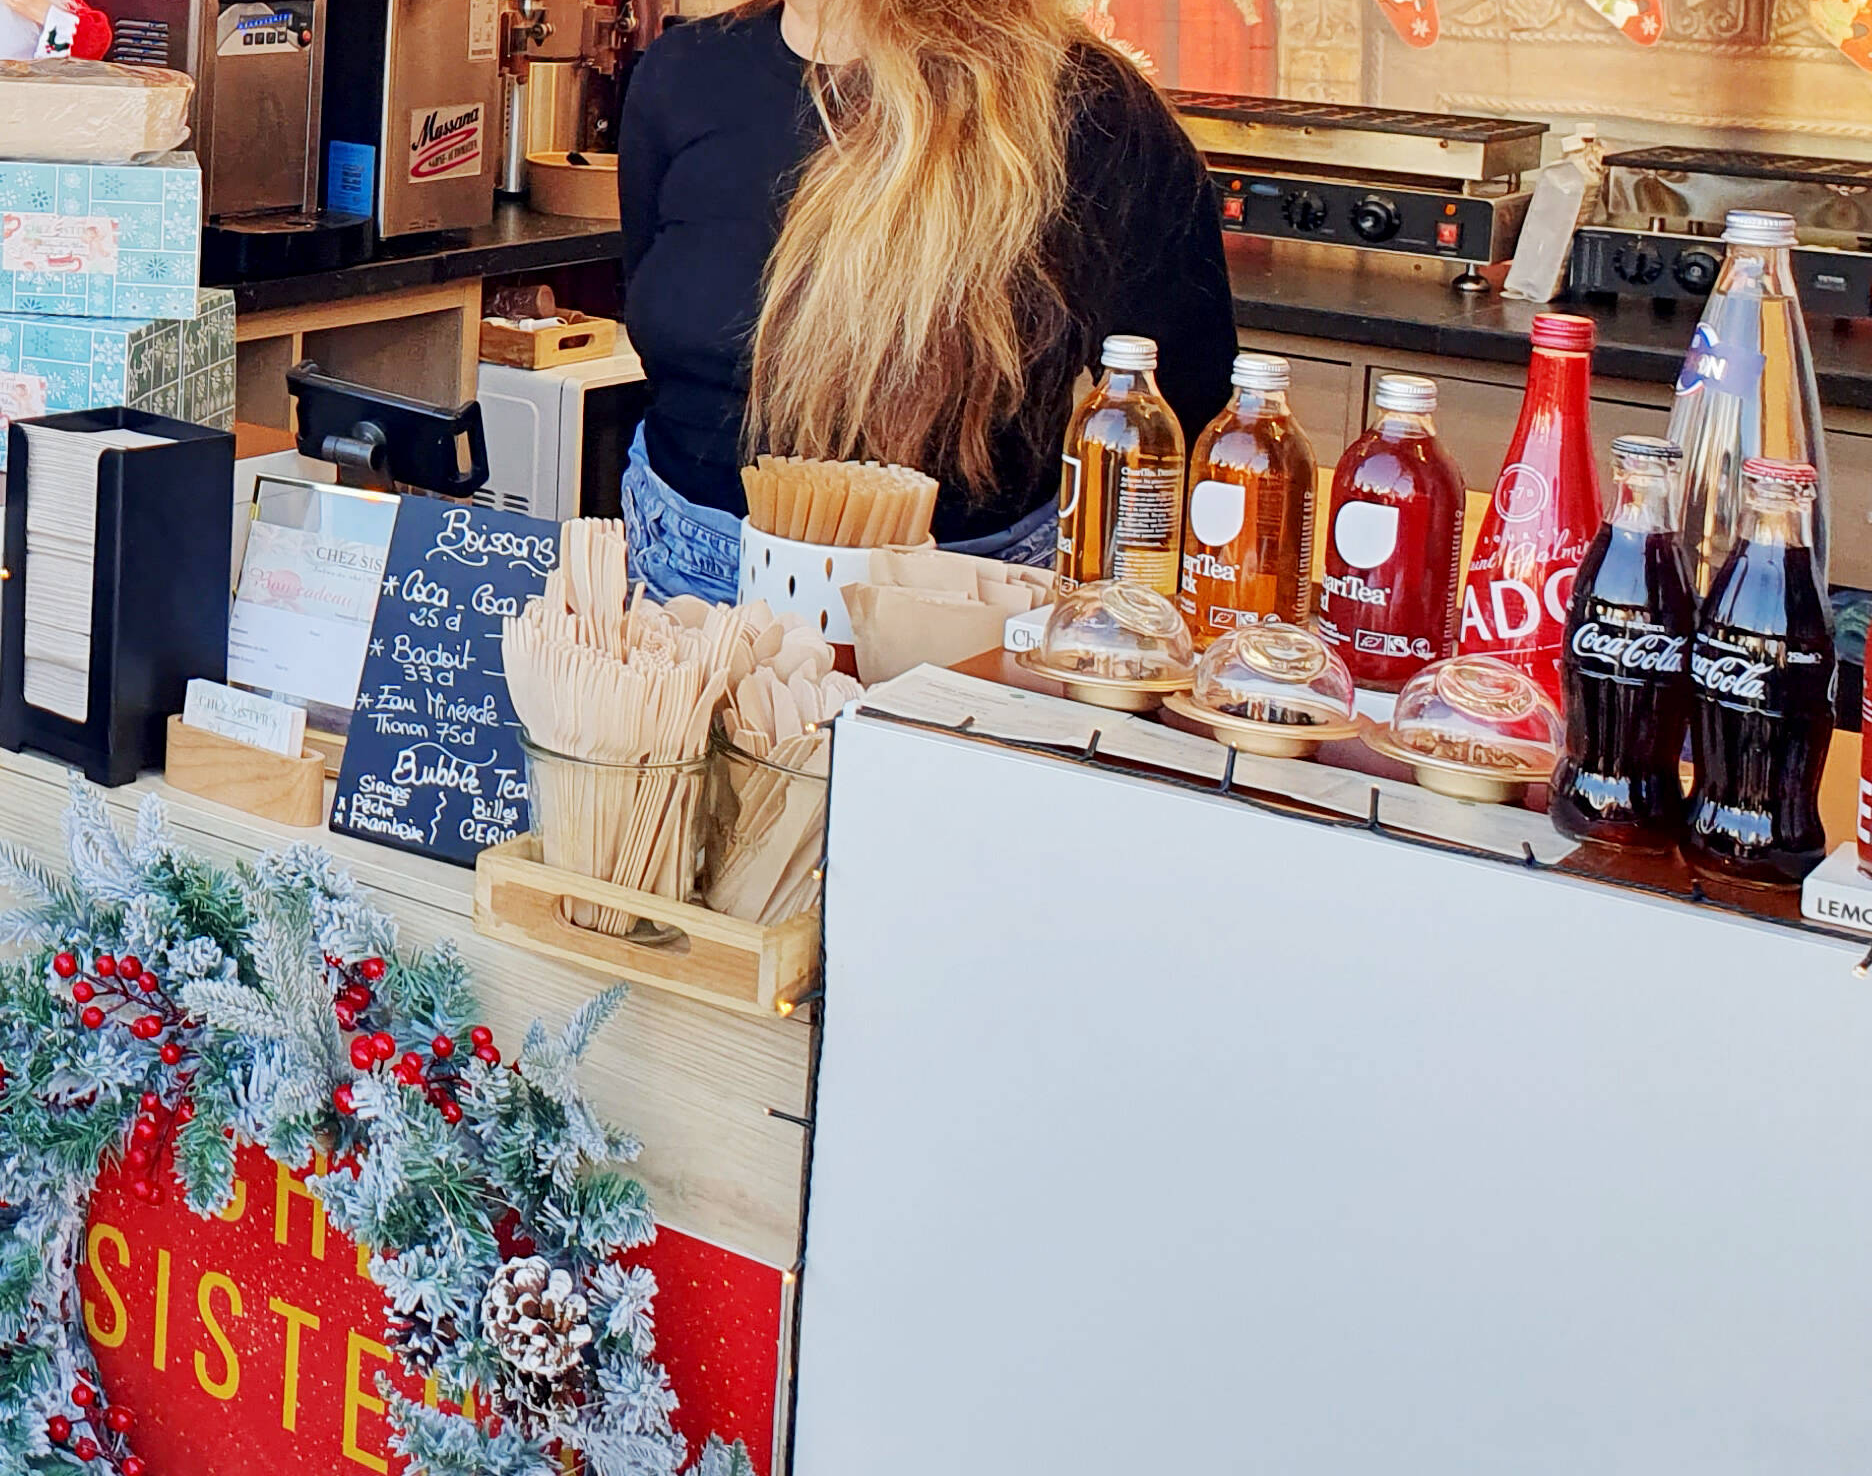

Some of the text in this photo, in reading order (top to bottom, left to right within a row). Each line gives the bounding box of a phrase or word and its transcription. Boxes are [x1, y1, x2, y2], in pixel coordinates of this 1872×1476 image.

[316, 547, 357, 566] CHEZ
[435, 508, 557, 567] Boissons
[402, 569, 449, 609] Coca
[409, 608, 439, 628] 25
[391, 633, 476, 672] Badoit
[1572, 622, 1688, 673] Coca-Cola
[405, 664, 432, 684] 33
[1691, 652, 1775, 701] ca-Cola
[368, 712, 429, 738] Thonon
[377, 684, 500, 727] Eau Minérale
[391, 748, 529, 801] Bubble Tea
[472, 797, 519, 822] Billes
